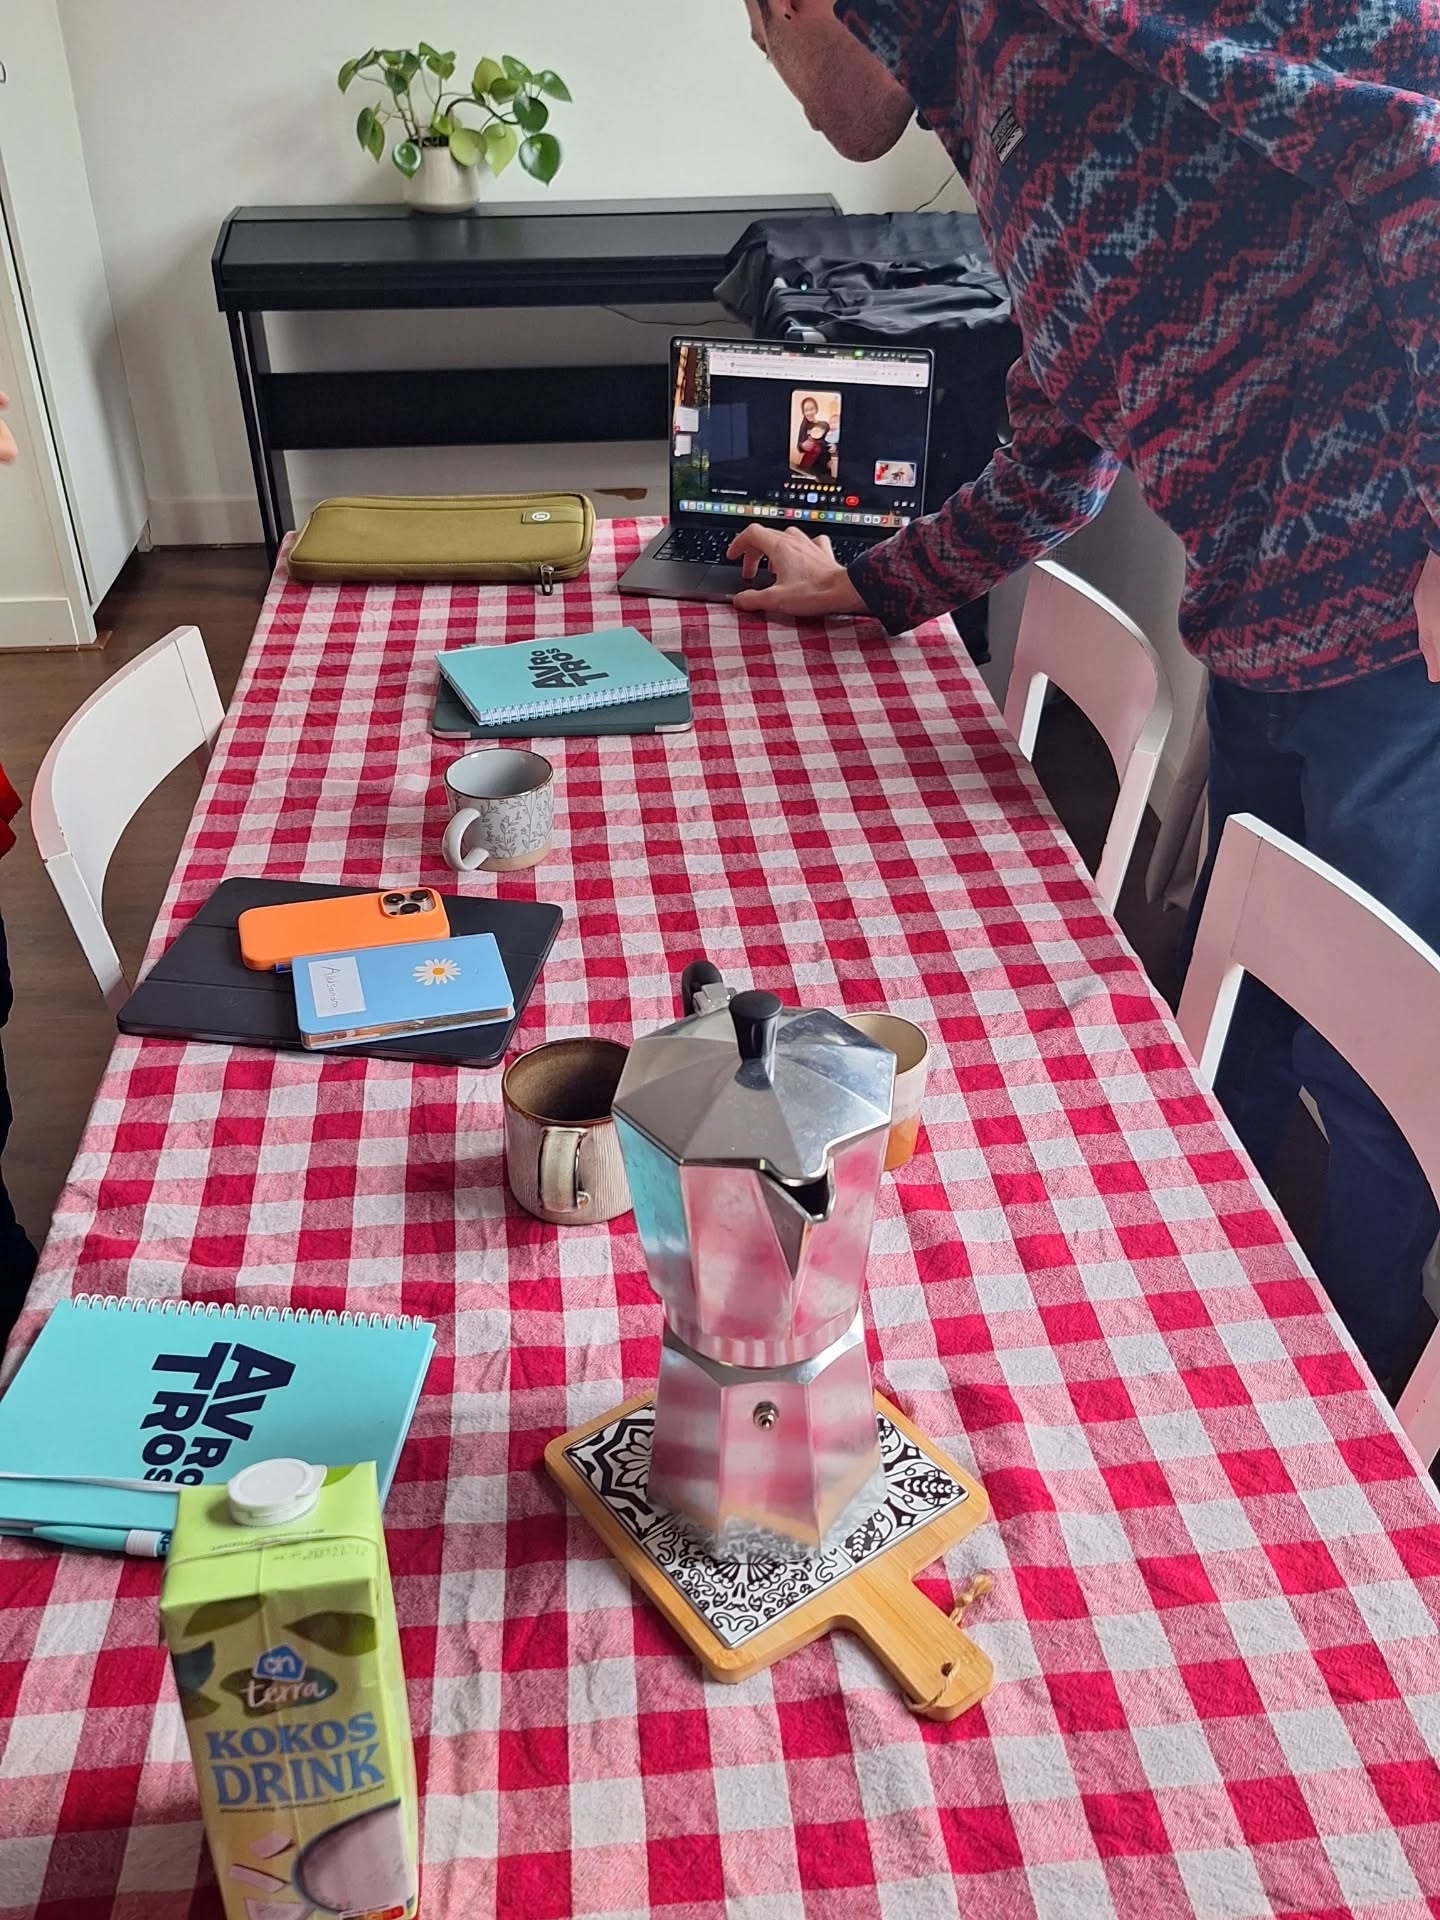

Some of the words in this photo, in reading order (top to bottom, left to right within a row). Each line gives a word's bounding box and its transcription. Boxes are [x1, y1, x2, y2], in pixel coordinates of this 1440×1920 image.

[240, 1679, 327, 1707] terra
[205, 1711, 378, 1760] KOKOS
[211, 1743, 385, 1806] DRINK
